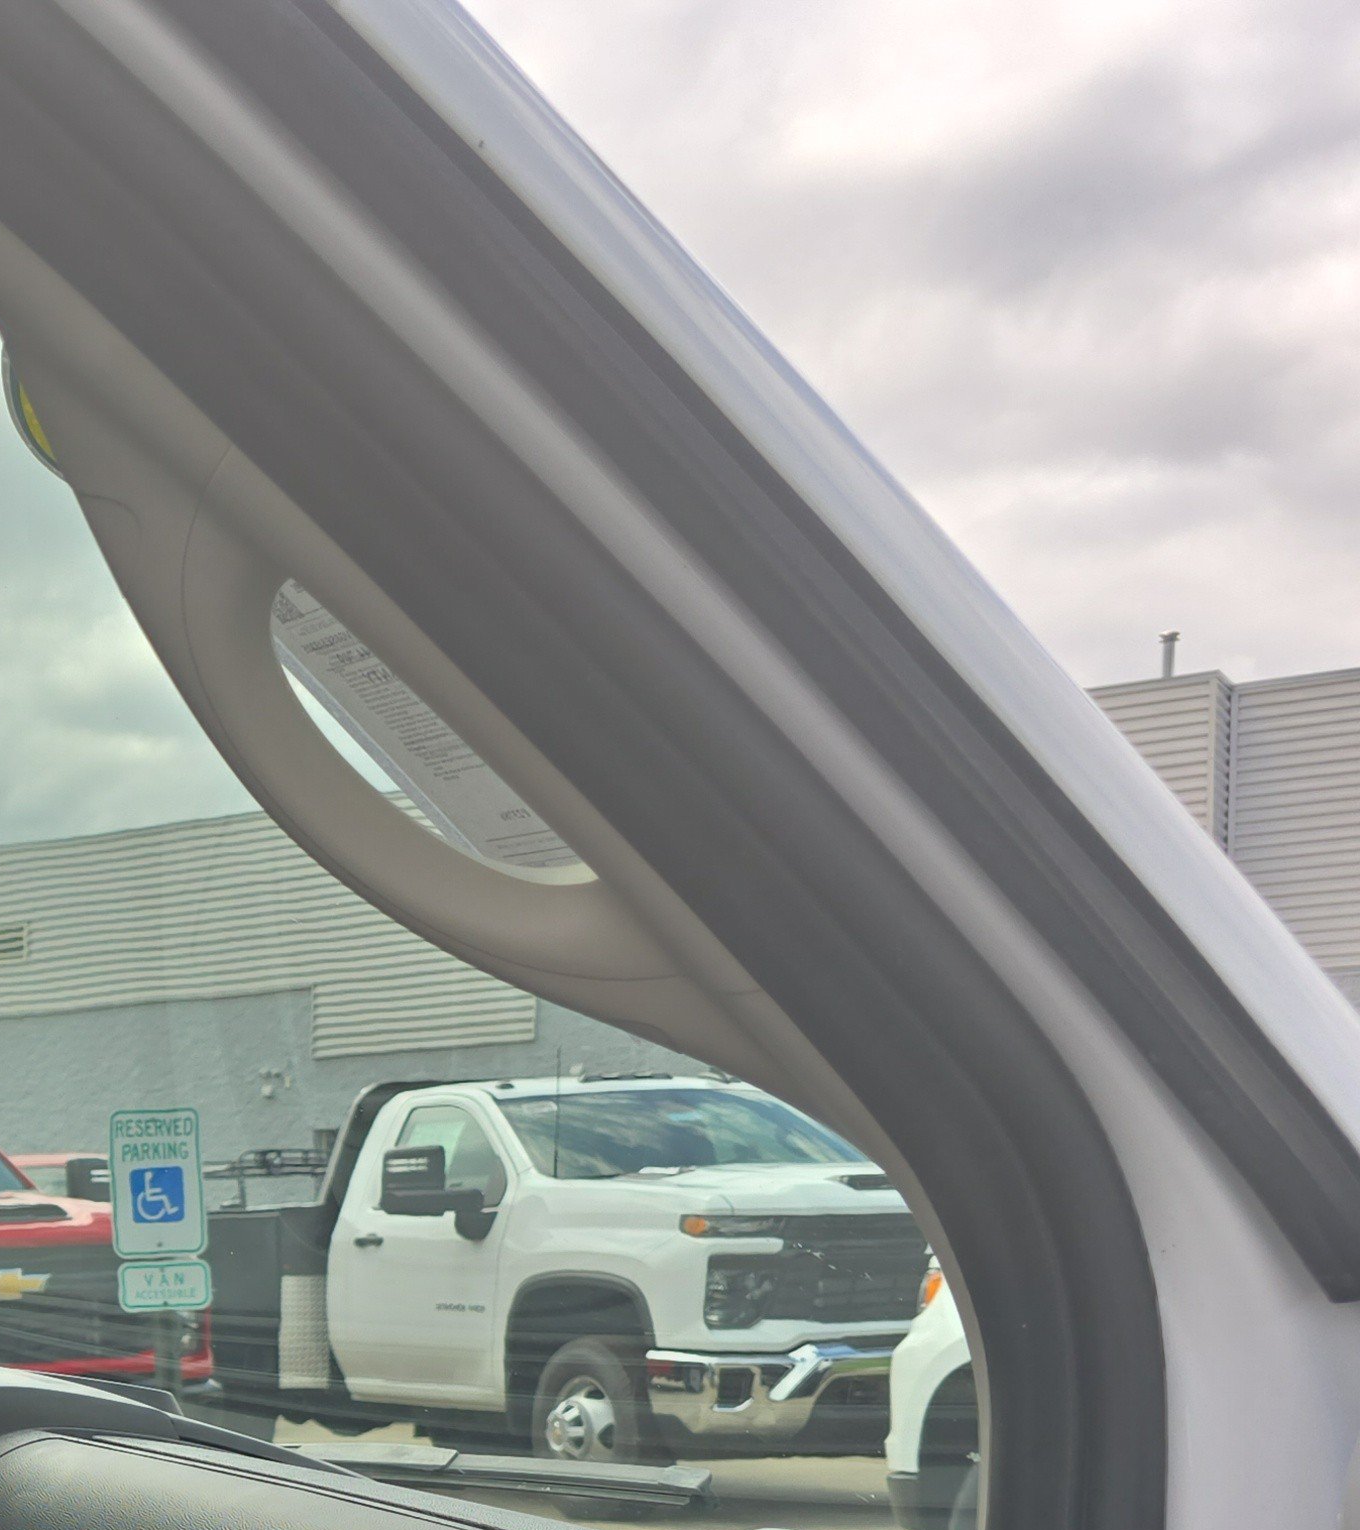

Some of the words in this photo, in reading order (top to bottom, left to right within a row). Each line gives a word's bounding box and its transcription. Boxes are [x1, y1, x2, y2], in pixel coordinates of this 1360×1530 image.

[115, 1117, 193, 1138] RESERVED
[122, 1141, 189, 1162] PARKING
[144, 1272, 185, 1286] VAN
